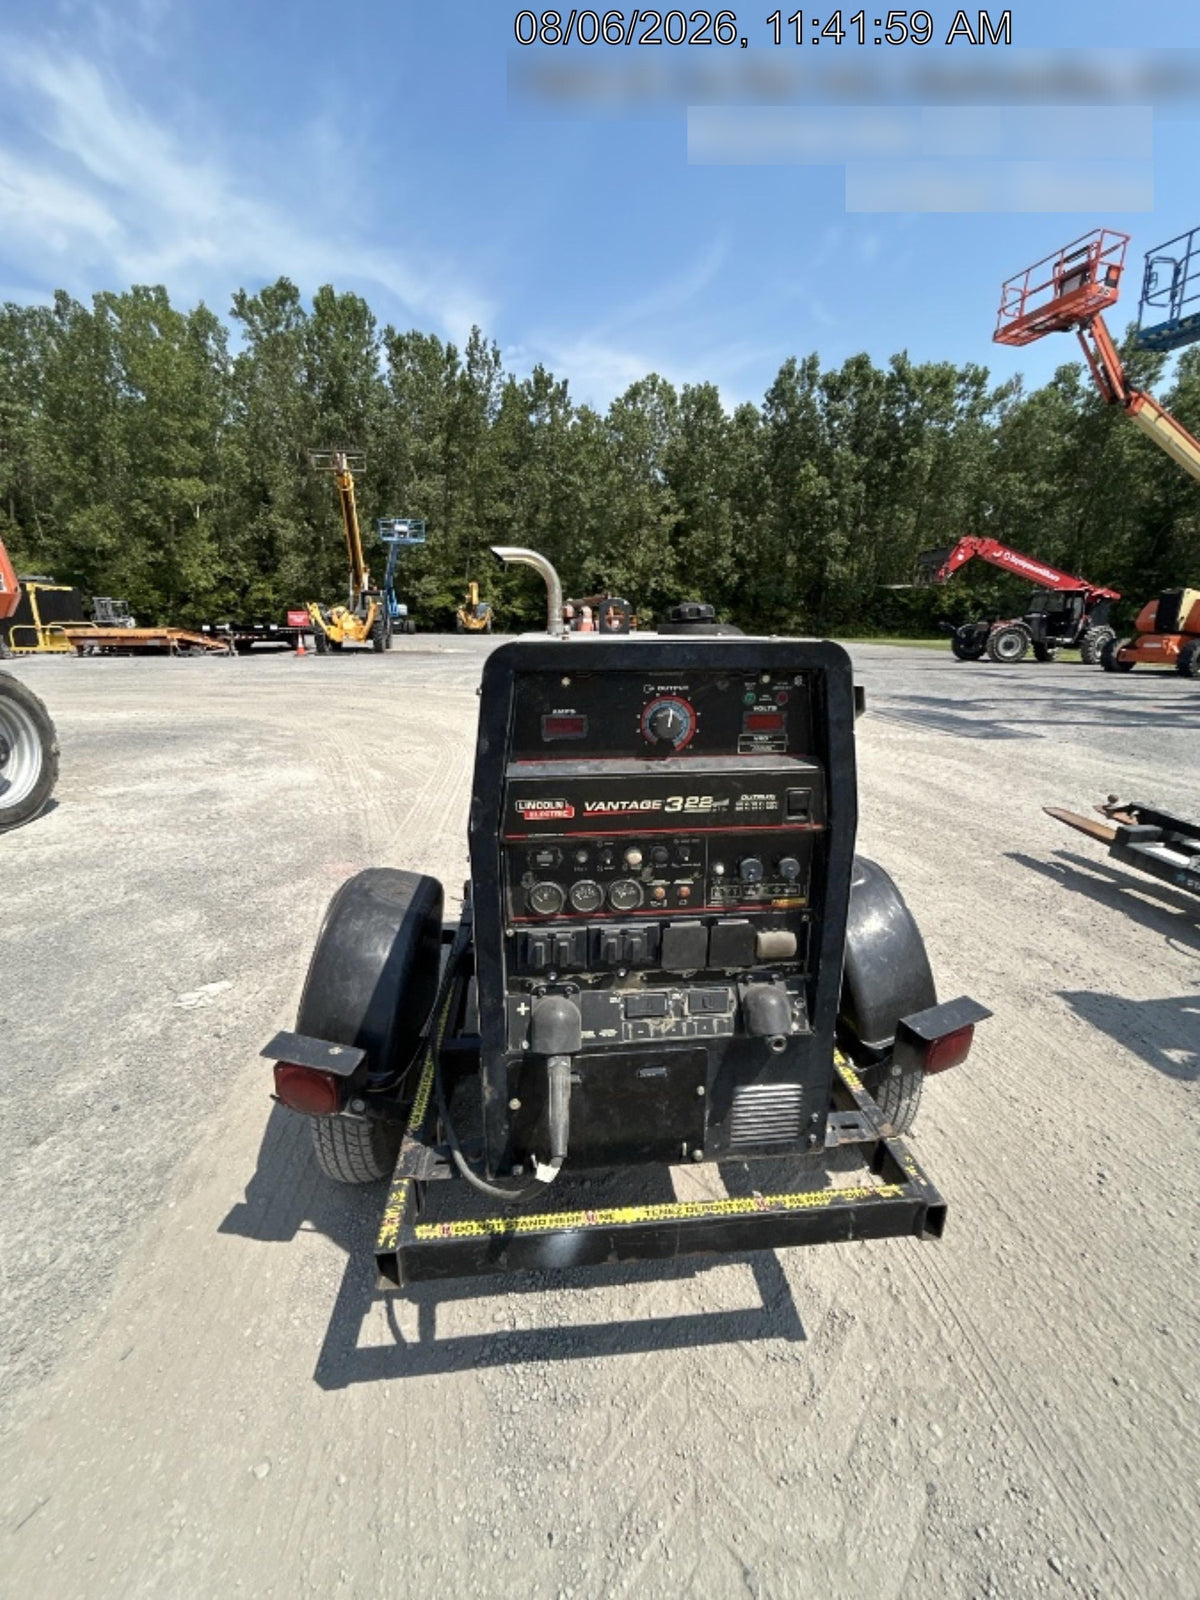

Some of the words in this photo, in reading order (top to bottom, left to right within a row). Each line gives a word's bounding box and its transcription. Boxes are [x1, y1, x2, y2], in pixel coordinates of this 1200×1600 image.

[518, 801, 564, 810] LINCOLN
[584, 799, 663, 812] VANTAGE
[664, 795, 715, 813] 322
[529, 810, 569, 818] ELECTRIC
[454, 1224, 474, 1233] DO
[476, 1221, 503, 1231] NOT
[505, 1217, 546, 1229] STAND
